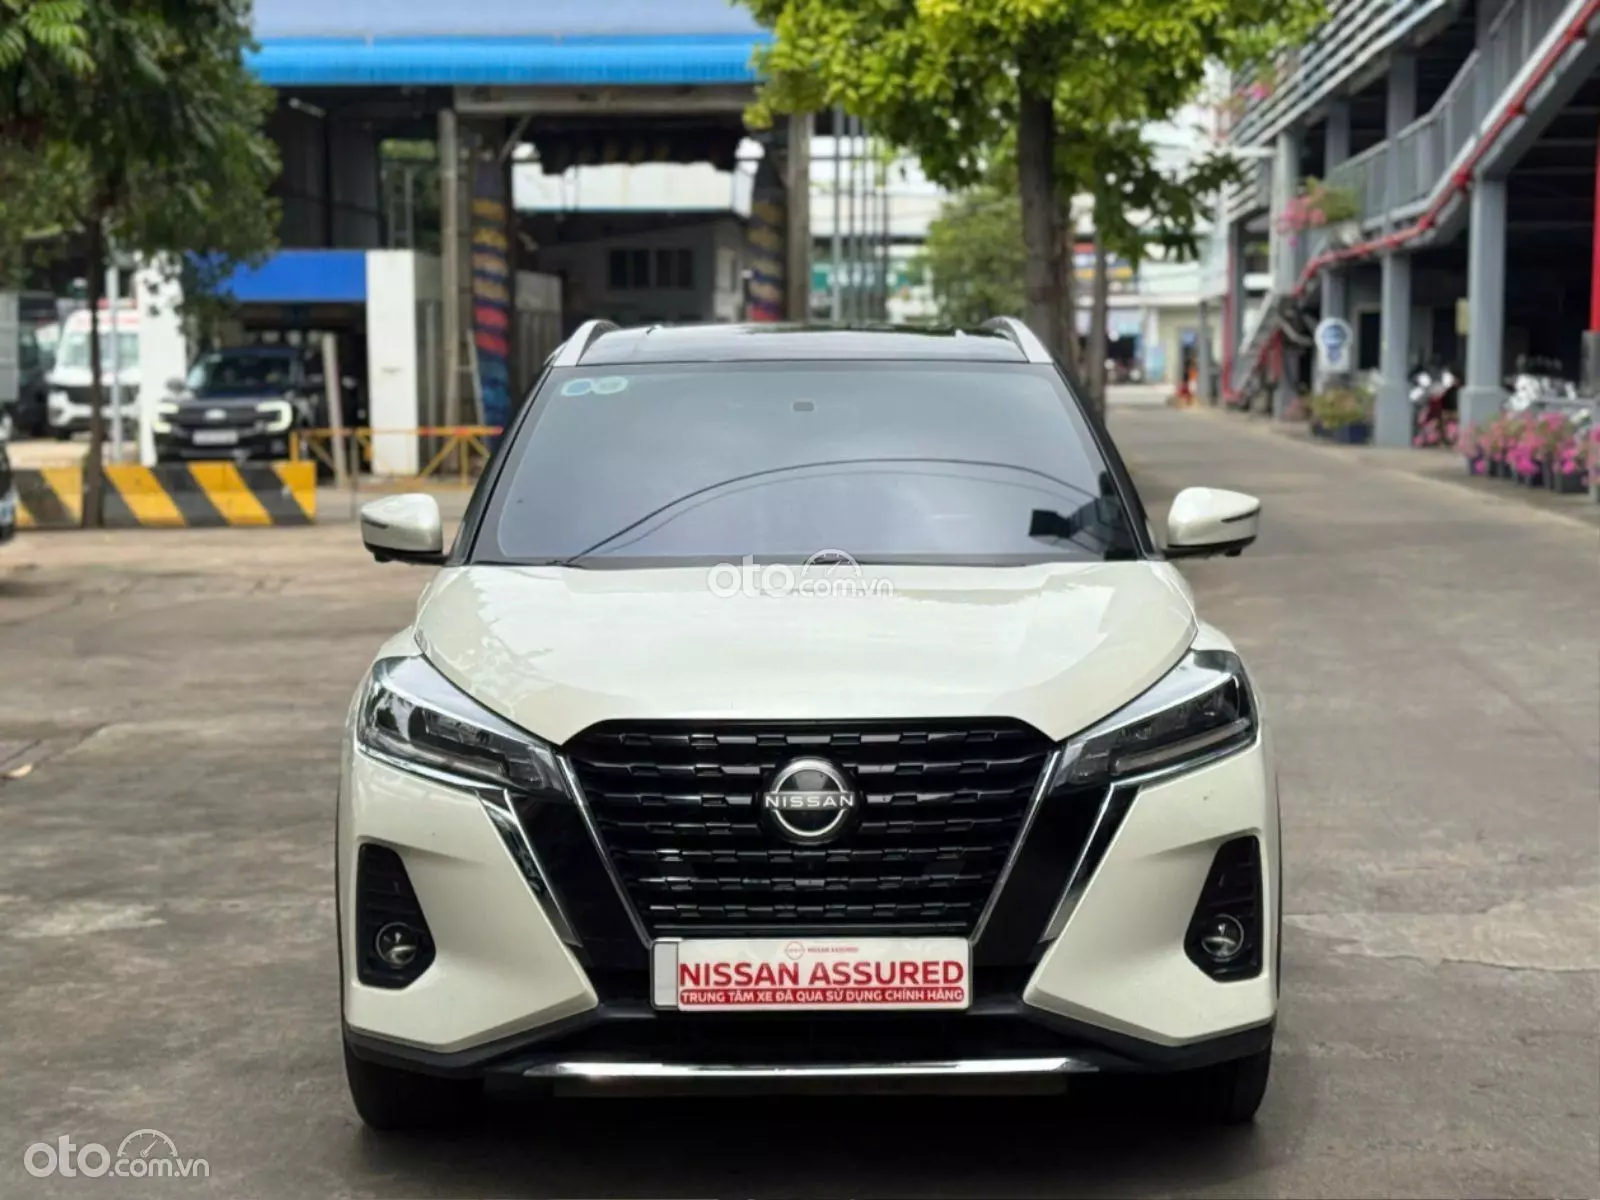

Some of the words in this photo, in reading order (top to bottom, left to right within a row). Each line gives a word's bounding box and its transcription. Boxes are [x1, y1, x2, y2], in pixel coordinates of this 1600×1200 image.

[765, 795, 853, 807] NISSAN
[679, 962, 799, 986] NISSAN
[808, 961, 964, 985] ASSURED
[682, 991, 725, 1002] TRUNG
[727, 989, 754, 1002] TÂM
[757, 991, 773, 1002] XE
[796, 990, 824, 1002] QUA
[884, 988, 924, 1001] CHÍNH
